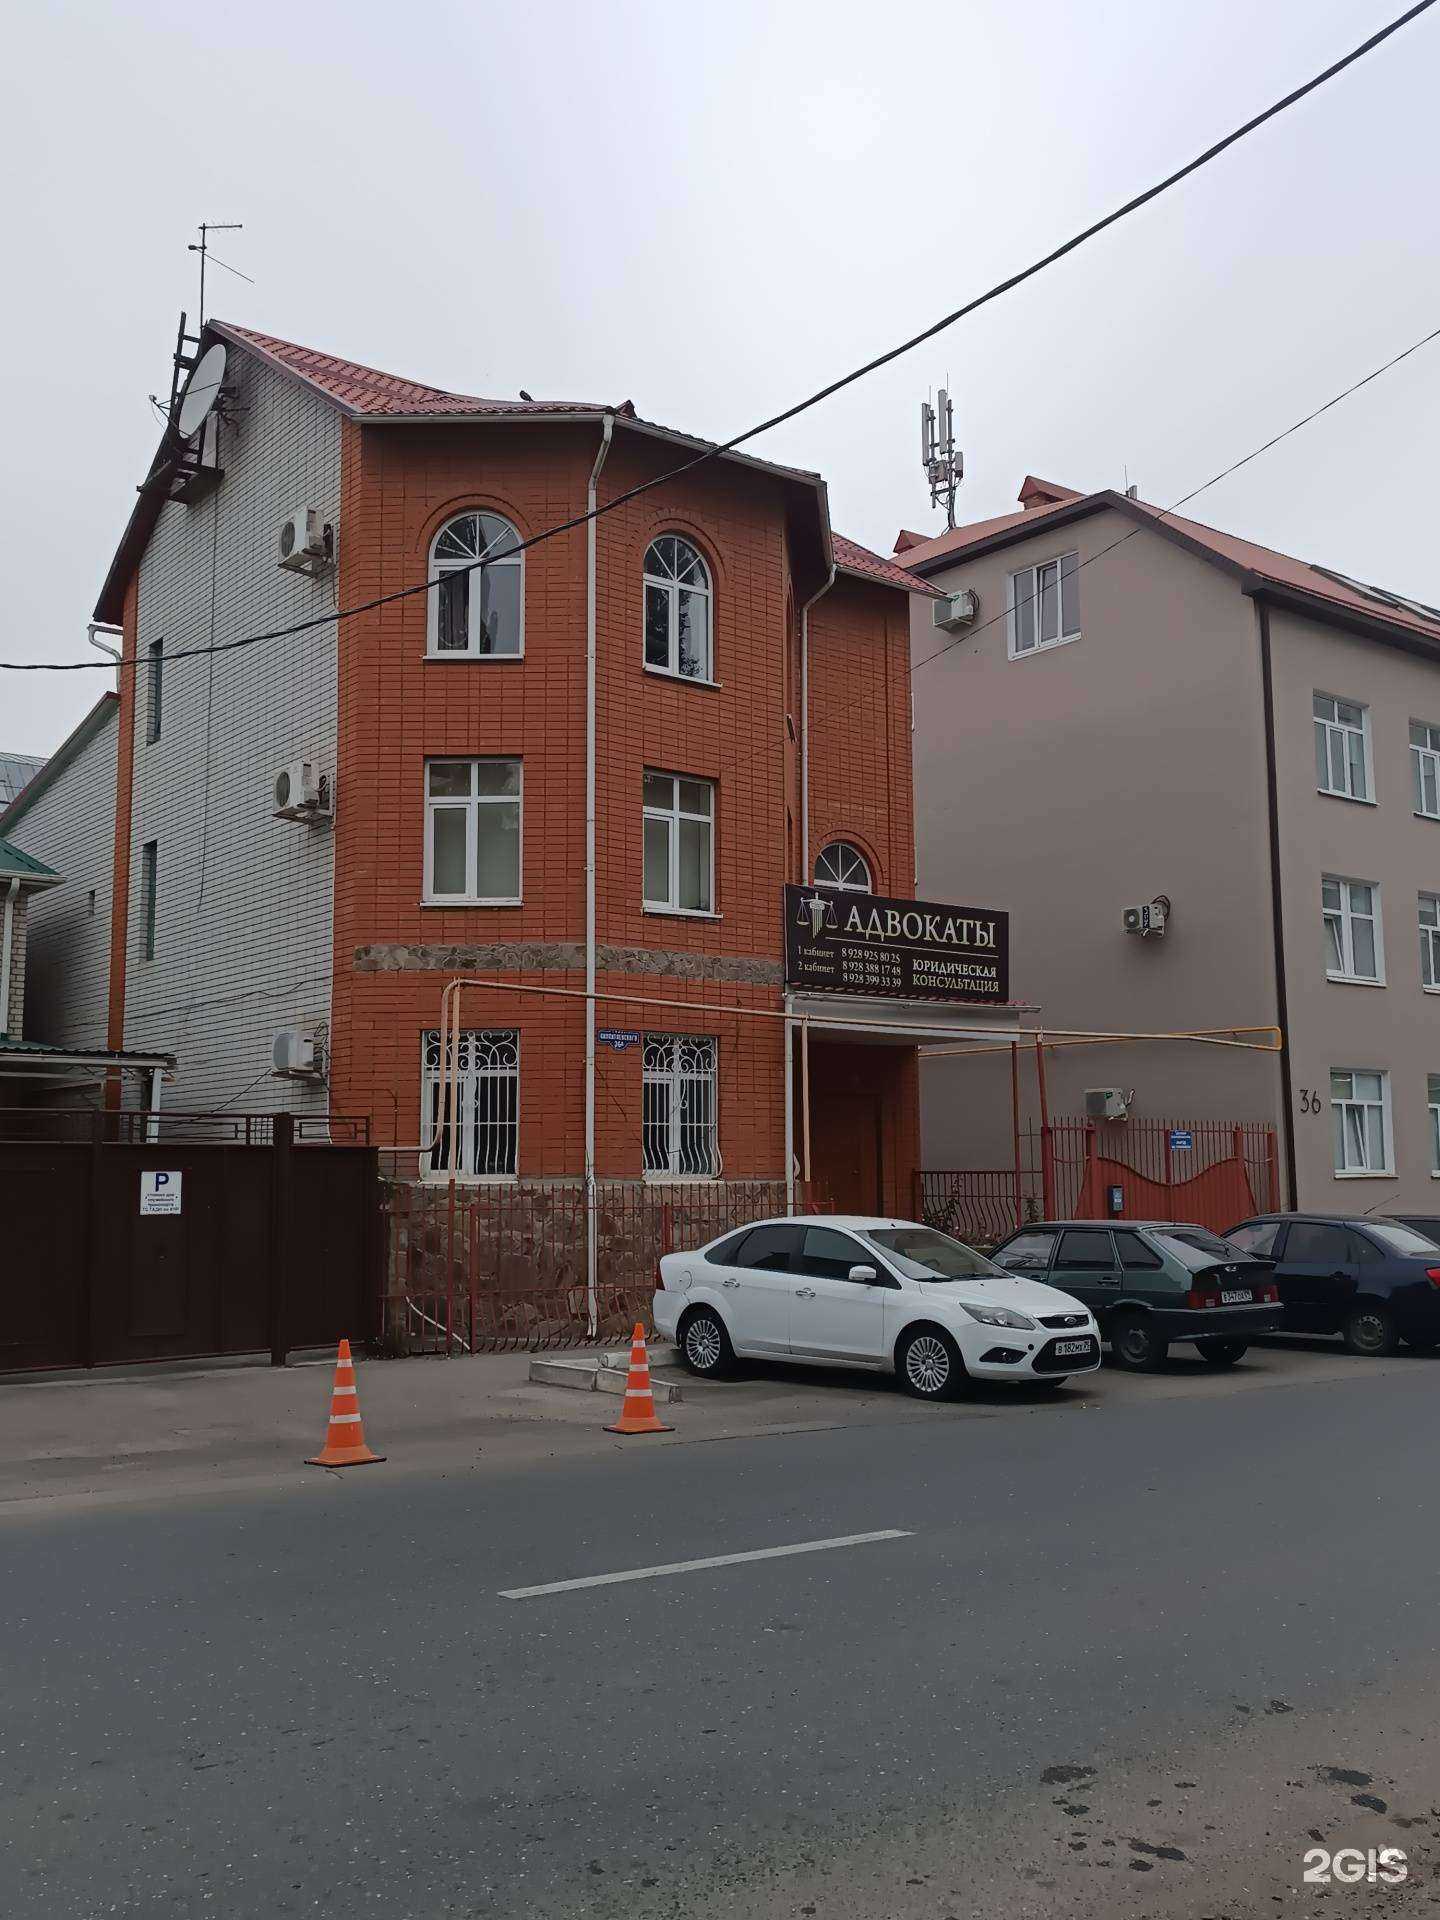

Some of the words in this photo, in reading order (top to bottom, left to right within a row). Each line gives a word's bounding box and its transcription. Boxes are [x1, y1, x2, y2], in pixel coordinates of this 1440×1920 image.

[844, 905, 996, 948] АДВОКАТЫ
[841, 947, 847, 957] 8
[848, 948, 862, 959] 928
[864, 950, 878, 961] 925
[880, 952, 890, 961] 80
[891, 953, 900, 963] 25
[842, 961, 848, 970] 8
[849, 961, 863, 972] 928
[865, 963, 879, 973] 388
[881, 965, 890, 974] 17
[912, 958, 997, 978] ЮРИДИЧЕСКАЯ
[842, 972, 848, 982] 8
[849, 973, 863, 983] 928
[865, 975, 879, 985] 399
[881, 977, 890, 987] 33
[892, 977, 901, 988] 39
[912, 974, 999, 993] КОНСУЛЬТАЦИЯ
[1299, 1089, 1321, 1114] 36
